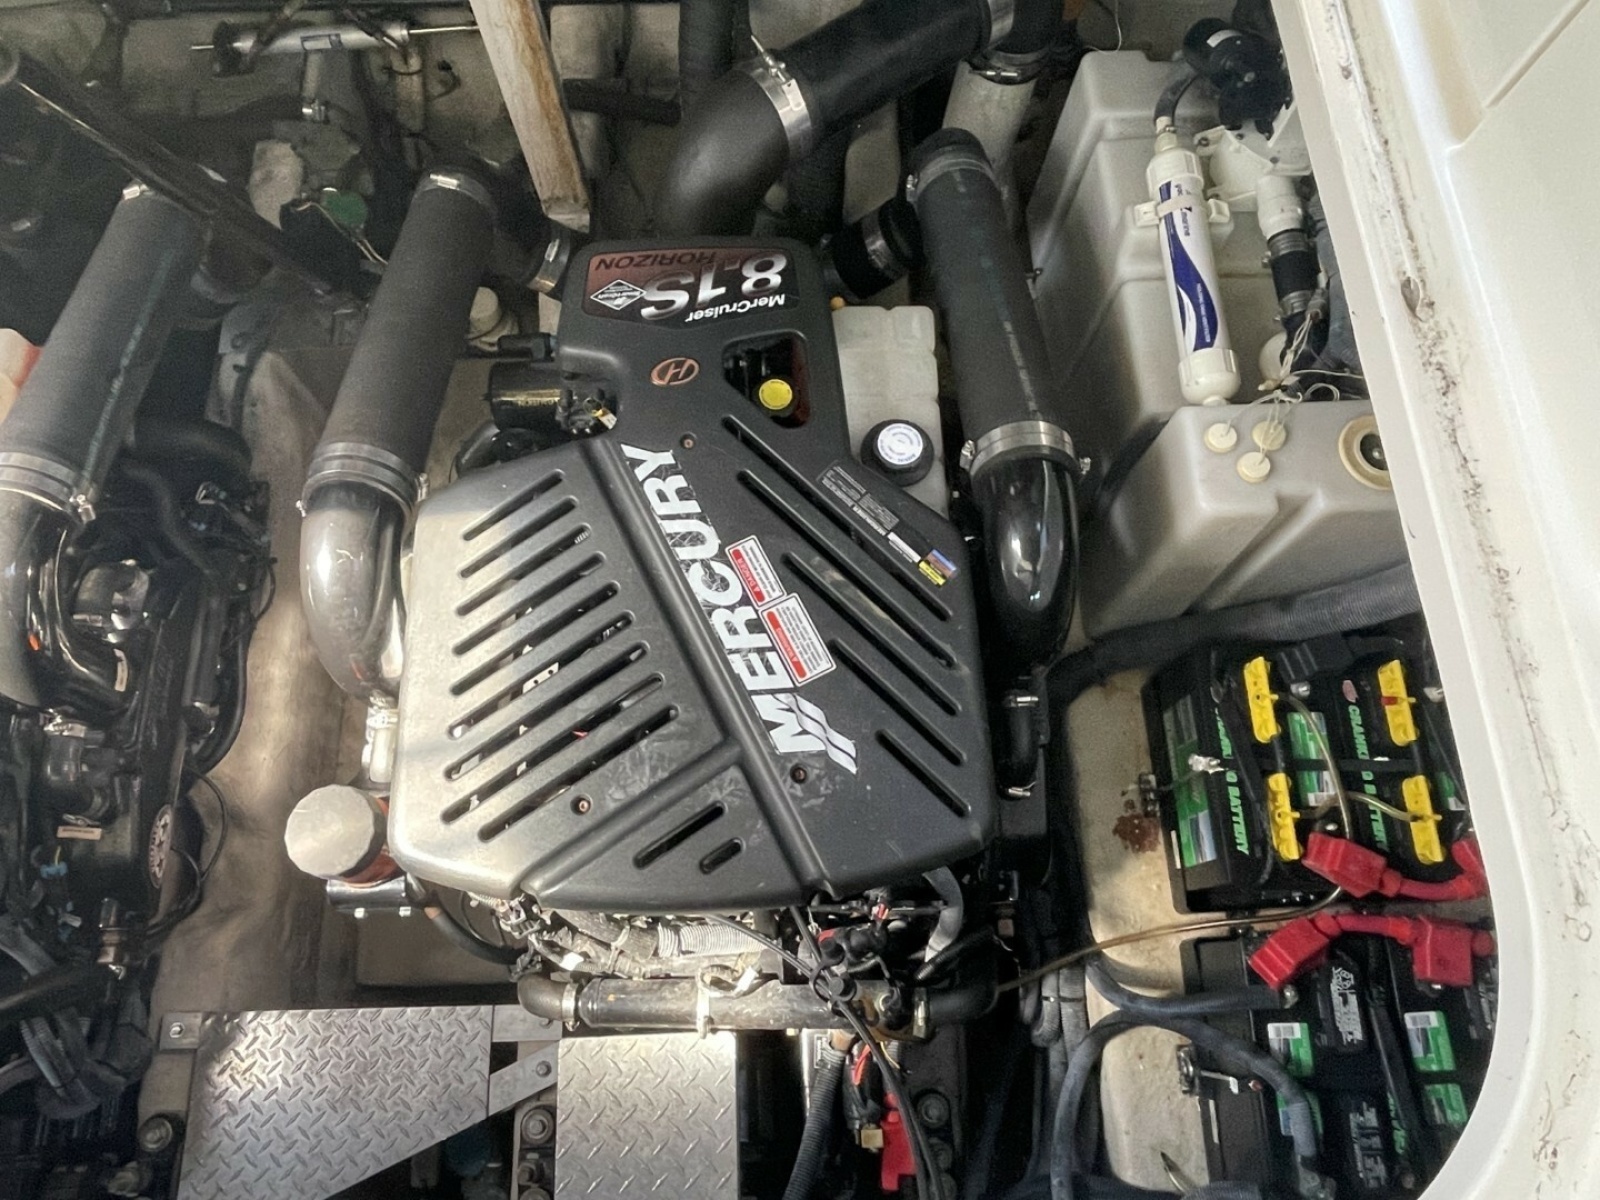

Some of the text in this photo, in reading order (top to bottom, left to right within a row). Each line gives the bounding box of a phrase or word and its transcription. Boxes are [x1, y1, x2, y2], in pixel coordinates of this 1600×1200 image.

[596, 251, 715, 270] HORIZON
[641, 253, 787, 321] 8.1S
[685, 294, 785, 322] MerCruiser
[737, 557, 756, 587] DANGER
[621, 444, 857, 773] MERCURY
[1348, 704, 1389, 850] CRANKIG BTTERY
[1228, 785, 1250, 856] BATTERY
